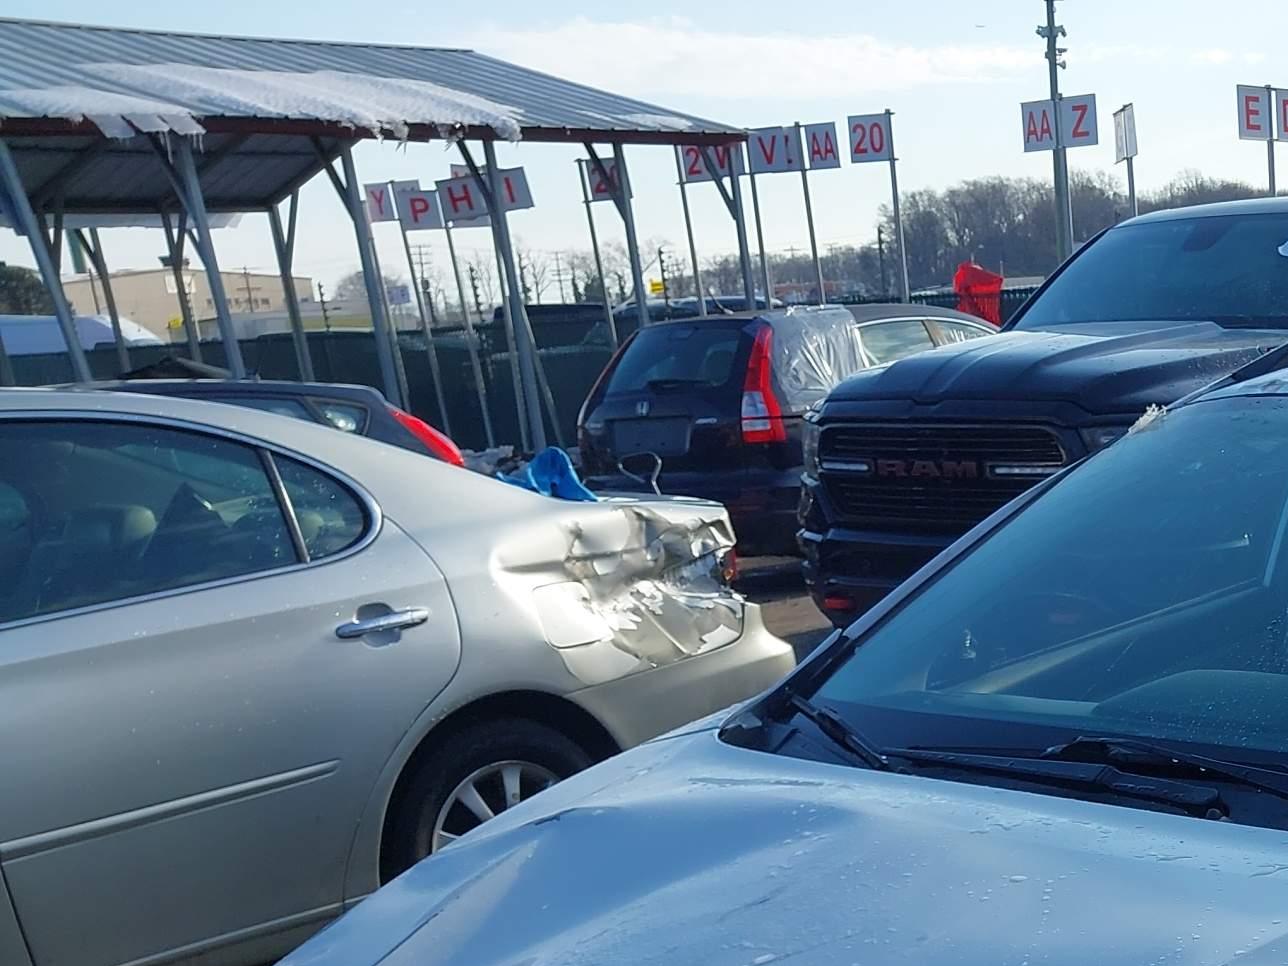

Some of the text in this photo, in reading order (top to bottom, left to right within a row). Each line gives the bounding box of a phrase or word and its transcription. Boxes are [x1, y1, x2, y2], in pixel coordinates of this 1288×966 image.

[1026, 109, 1053, 143] AA
[1071, 104, 1090, 138] Z
[1245, 95, 1261, 131] E
[757, 134, 777, 165] V
[811, 131, 837, 162] AA
[852, 121, 884, 155] 20
[370, 189, 384, 215] Y
[410, 198, 429, 224] P
[447, 183, 475, 214] H
[877, 459, 977, 479] RAM
